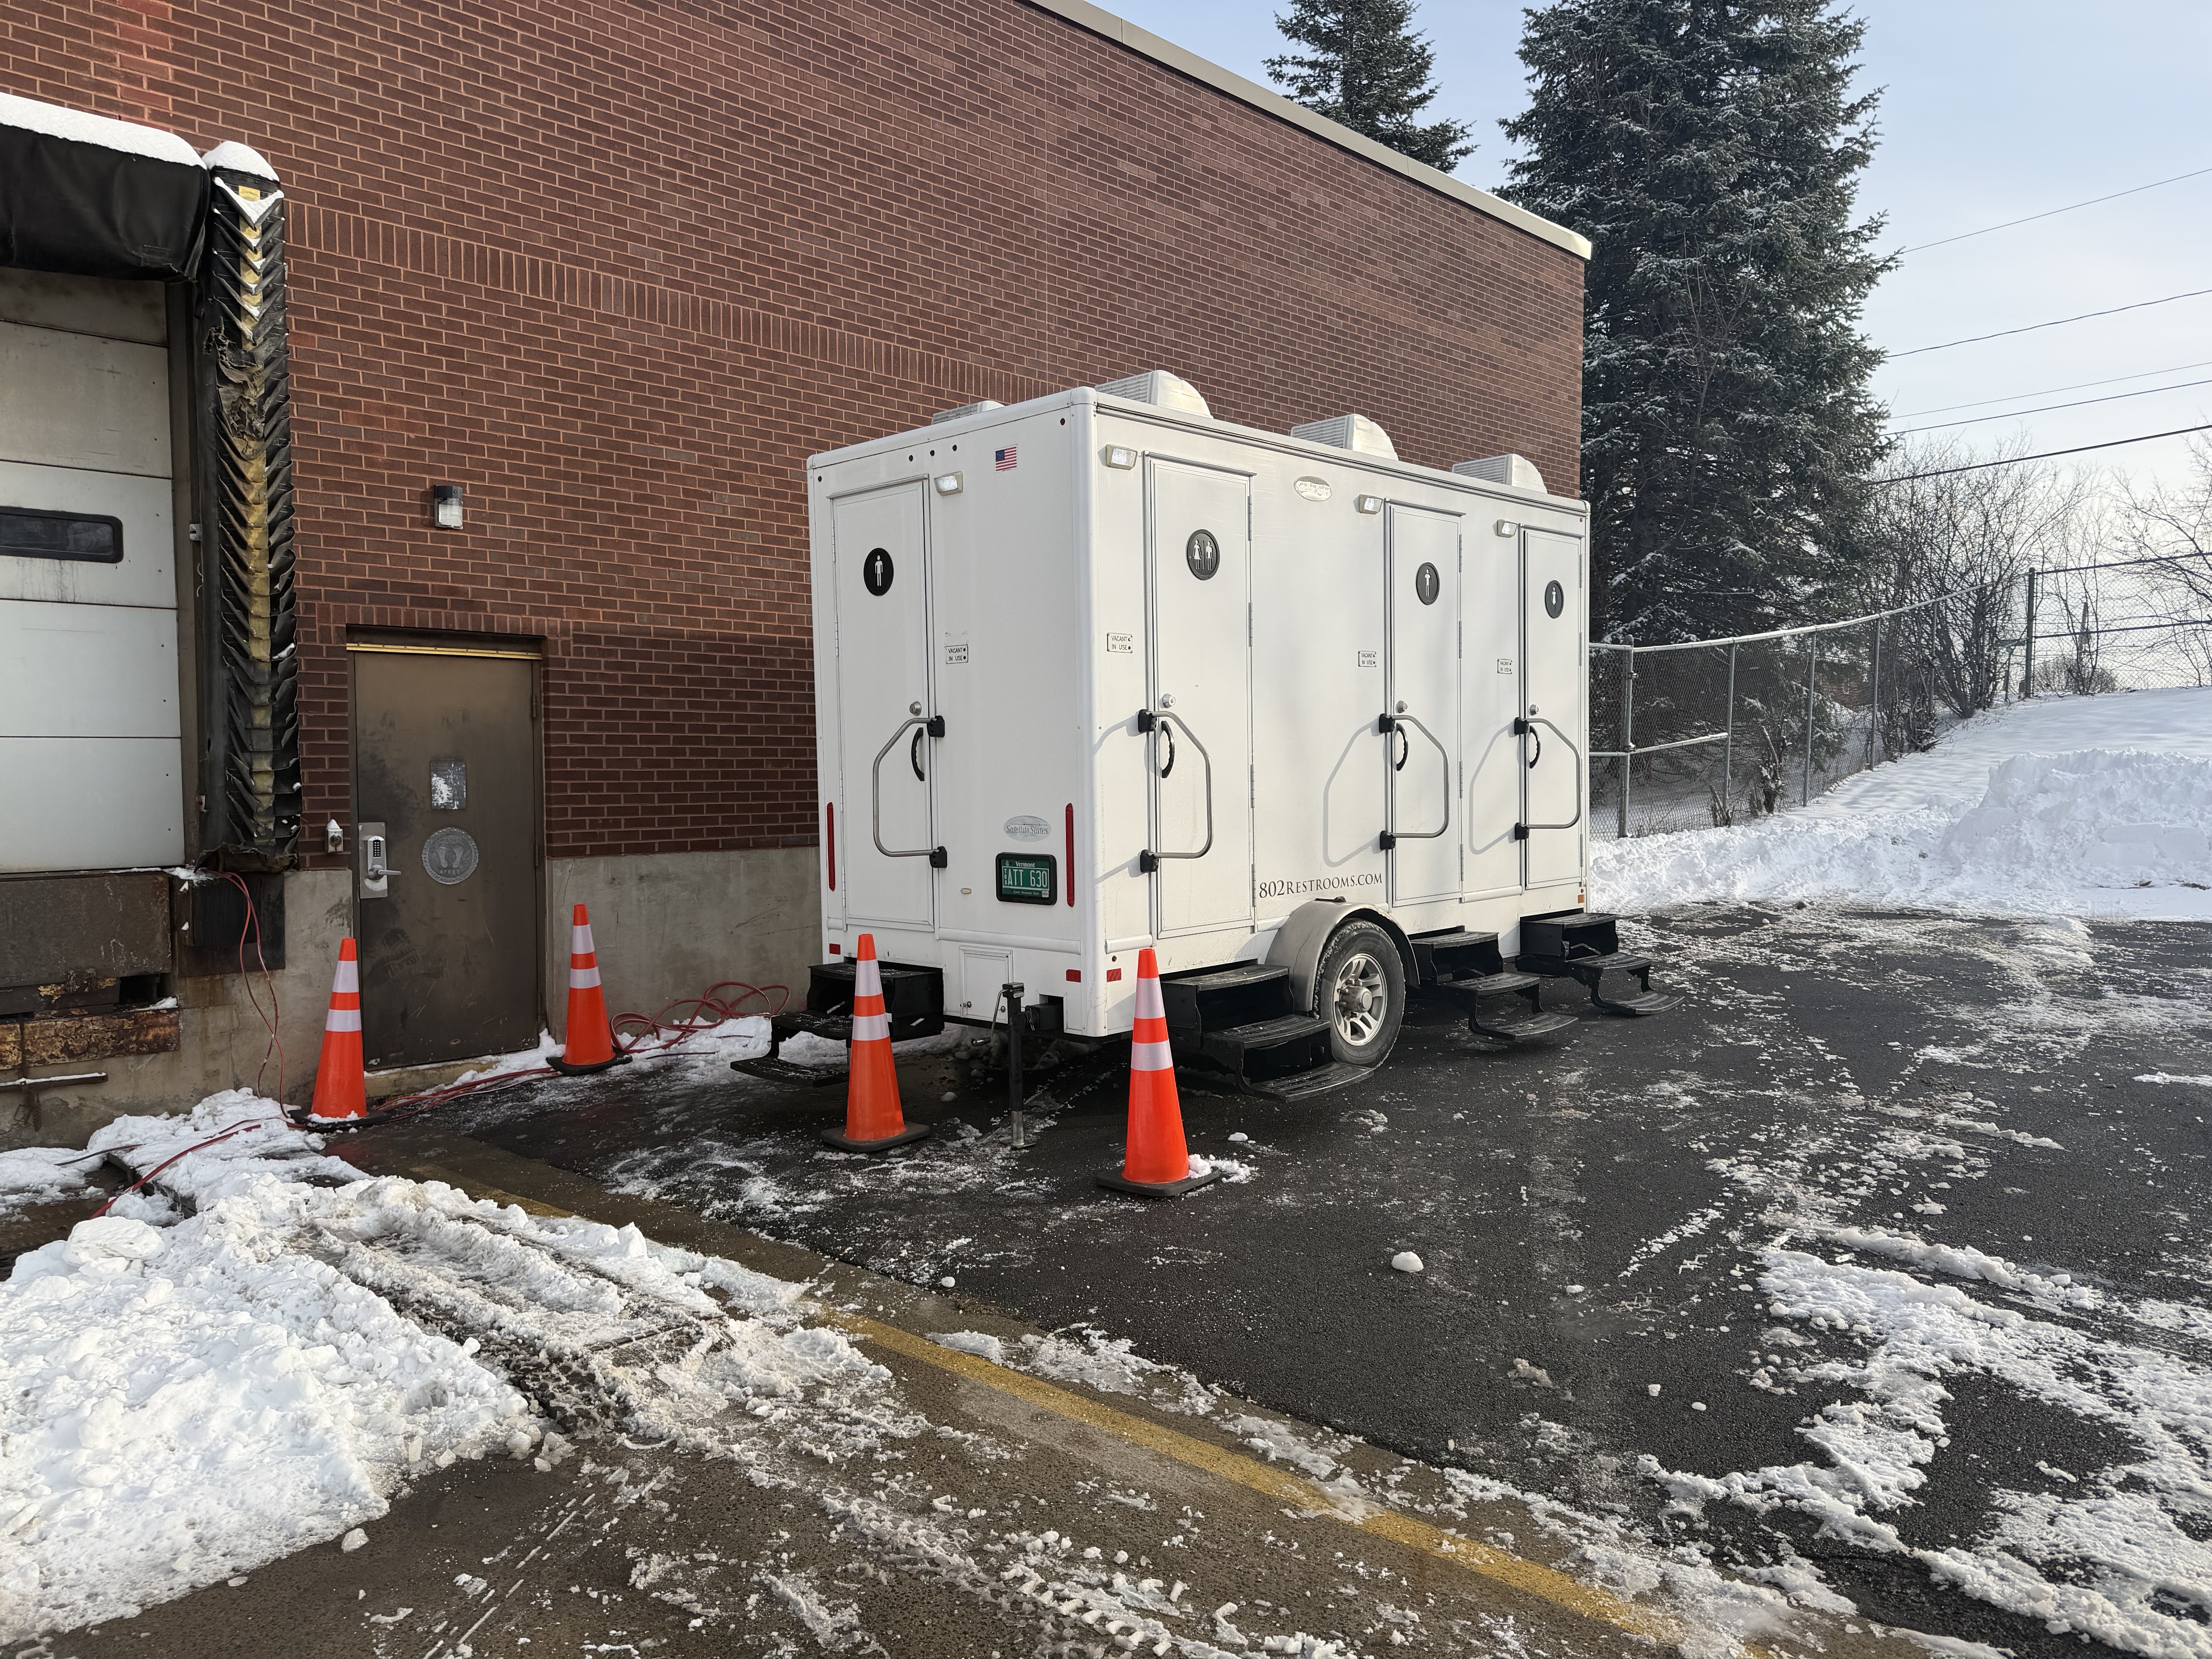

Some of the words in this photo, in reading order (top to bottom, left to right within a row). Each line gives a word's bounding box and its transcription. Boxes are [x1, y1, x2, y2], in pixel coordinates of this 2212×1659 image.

[1006, 825, 1029, 834] Satellite
[1030, 826, 1048, 835] Suites
[1008, 869, 1024, 886] ATT
[1030, 870, 1047, 888] 630
[1259, 873, 1382, 898] 802RESTROOMS.COM
